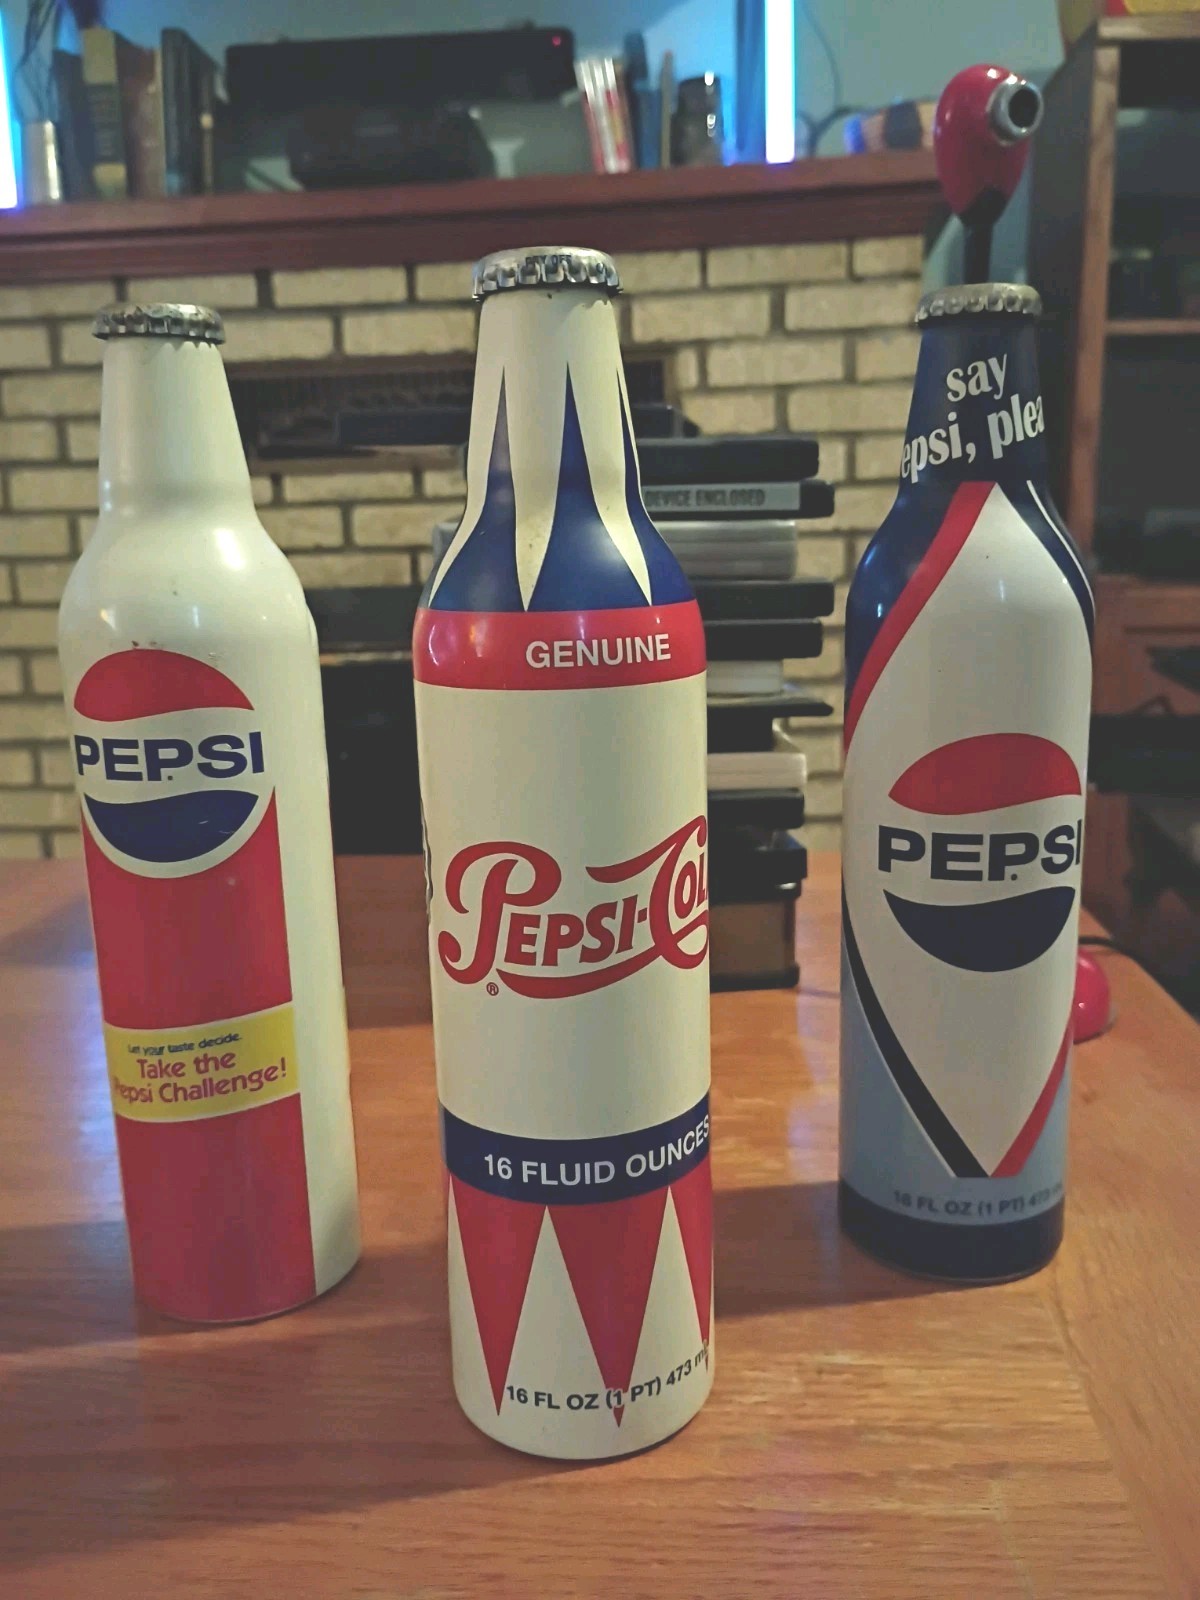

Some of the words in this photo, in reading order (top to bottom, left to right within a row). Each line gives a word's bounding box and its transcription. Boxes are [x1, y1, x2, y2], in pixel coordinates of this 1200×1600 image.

[946, 353, 1007, 402] say
[644, 490, 690, 508] DEVICE
[696, 488, 765, 507] ENCLOSED
[525, 633, 672, 669] GENUINE
[74, 731, 265, 782] PEPSI
[878, 818, 1082, 882] PEPSI
[437, 814, 709, 999] PEPSI-COL
[136, 1059, 186, 1079] Take
[193, 1051, 236, 1074] the
[158, 1056, 287, 1103] Challenge!
[484, 1153, 513, 1180] 16
[521, 1160, 616, 1186] FLUID
[625, 1114, 710, 1178] OUNCES
[892, 1190, 912, 1208] 16
[917, 1196, 939, 1213] FL
[945, 1199, 972, 1216] OZ
[507, 1385, 529, 1404] 16
[534, 1391, 561, 1410] FL
[566, 1393, 599, 1411] OZ
[605, 1389, 623, 1409] (1
[630, 1376, 662, 1403] PT)
[666, 1358, 692, 1386] 473
